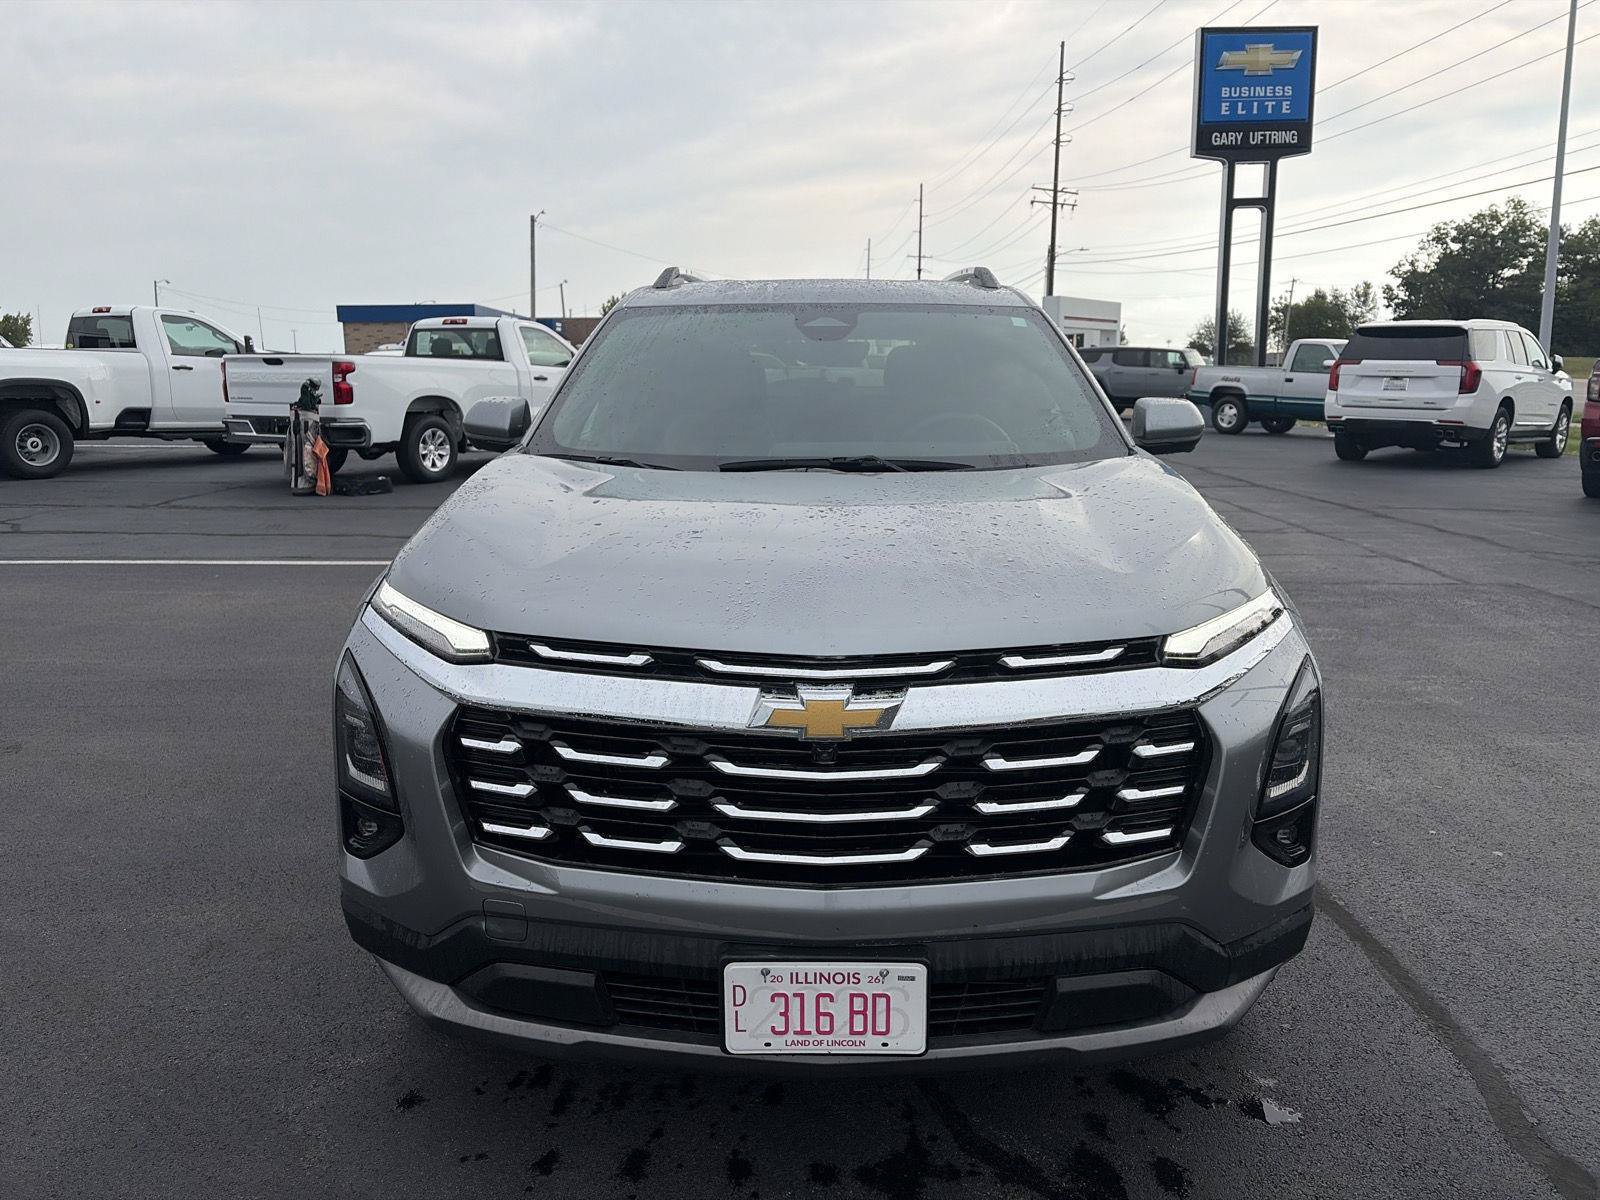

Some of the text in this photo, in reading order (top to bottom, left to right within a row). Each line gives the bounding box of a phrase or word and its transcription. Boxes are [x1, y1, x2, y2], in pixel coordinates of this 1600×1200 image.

[1221, 85, 1293, 98] BUSINESS
[1221, 101, 1292, 115] ELITE
[1211, 130, 1298, 146] GARY UFTRING
[769, 974, 784, 984] 20
[789, 971, 862, 985] ILLINOIS
[867, 974, 881, 984] 26
[769, 992, 892, 1036] 316 BD
[784, 1039, 866, 1047] LAND OF LINCOLN
